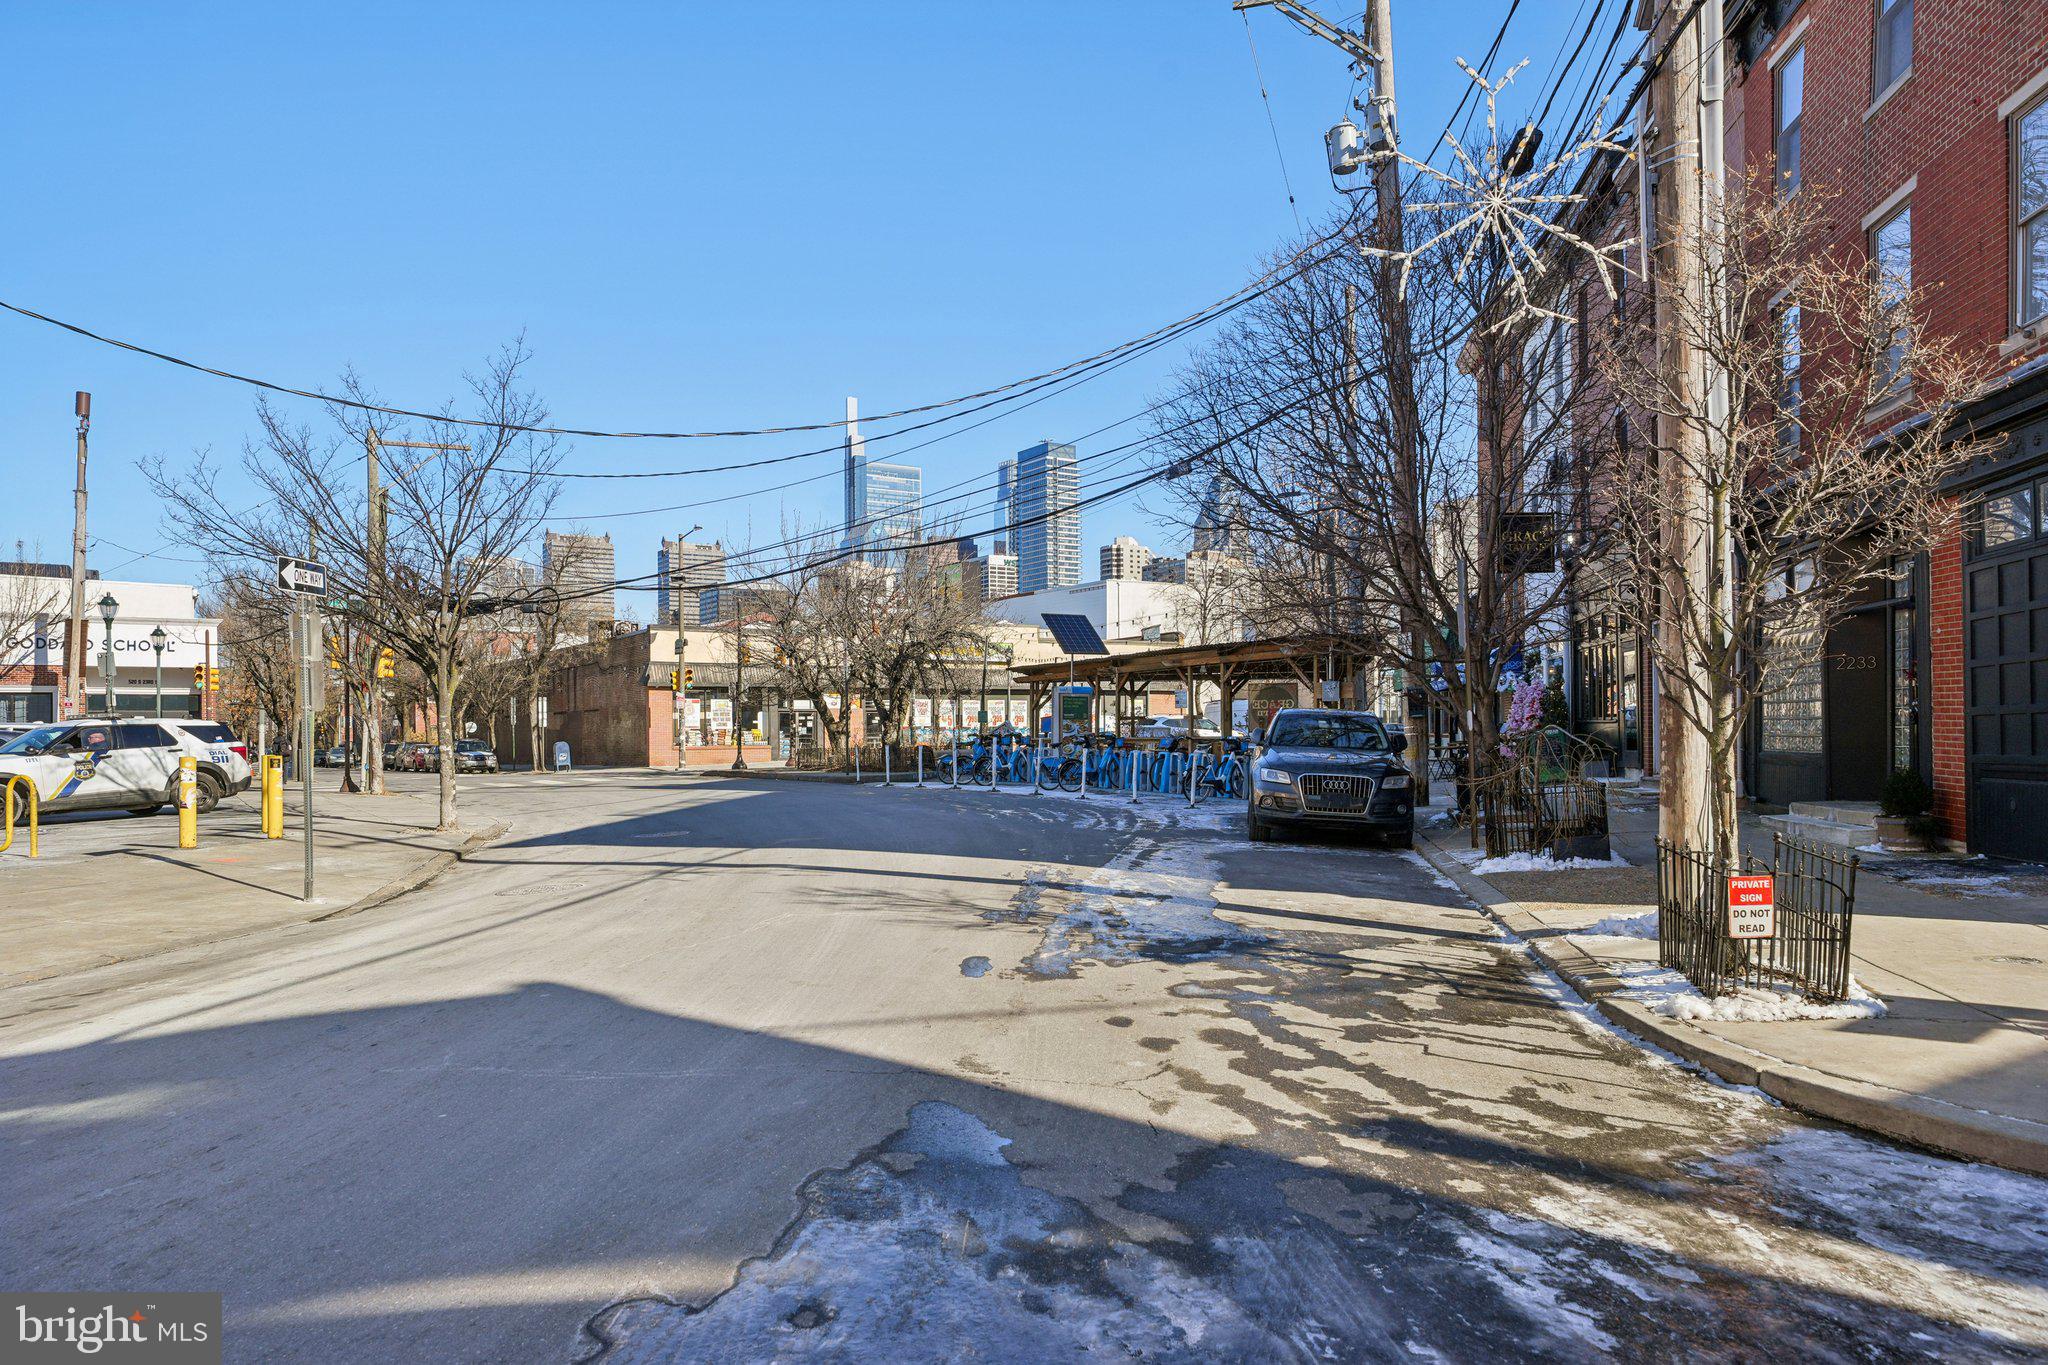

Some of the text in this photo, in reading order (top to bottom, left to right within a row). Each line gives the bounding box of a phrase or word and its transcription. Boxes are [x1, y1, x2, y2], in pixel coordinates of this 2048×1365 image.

[294, 569, 322, 586] ONE WAY
[6, 637, 175, 653] GODDD SCHOL
[1836, 655, 1877, 670] 2233
[211, 755, 229, 763] 911
[1731, 880, 1770, 889] PRIVATE
[1740, 893, 1763, 902] SIGN
[1733, 909, 1771, 918] DO NOT
[1739, 924, 1765, 933] READ
